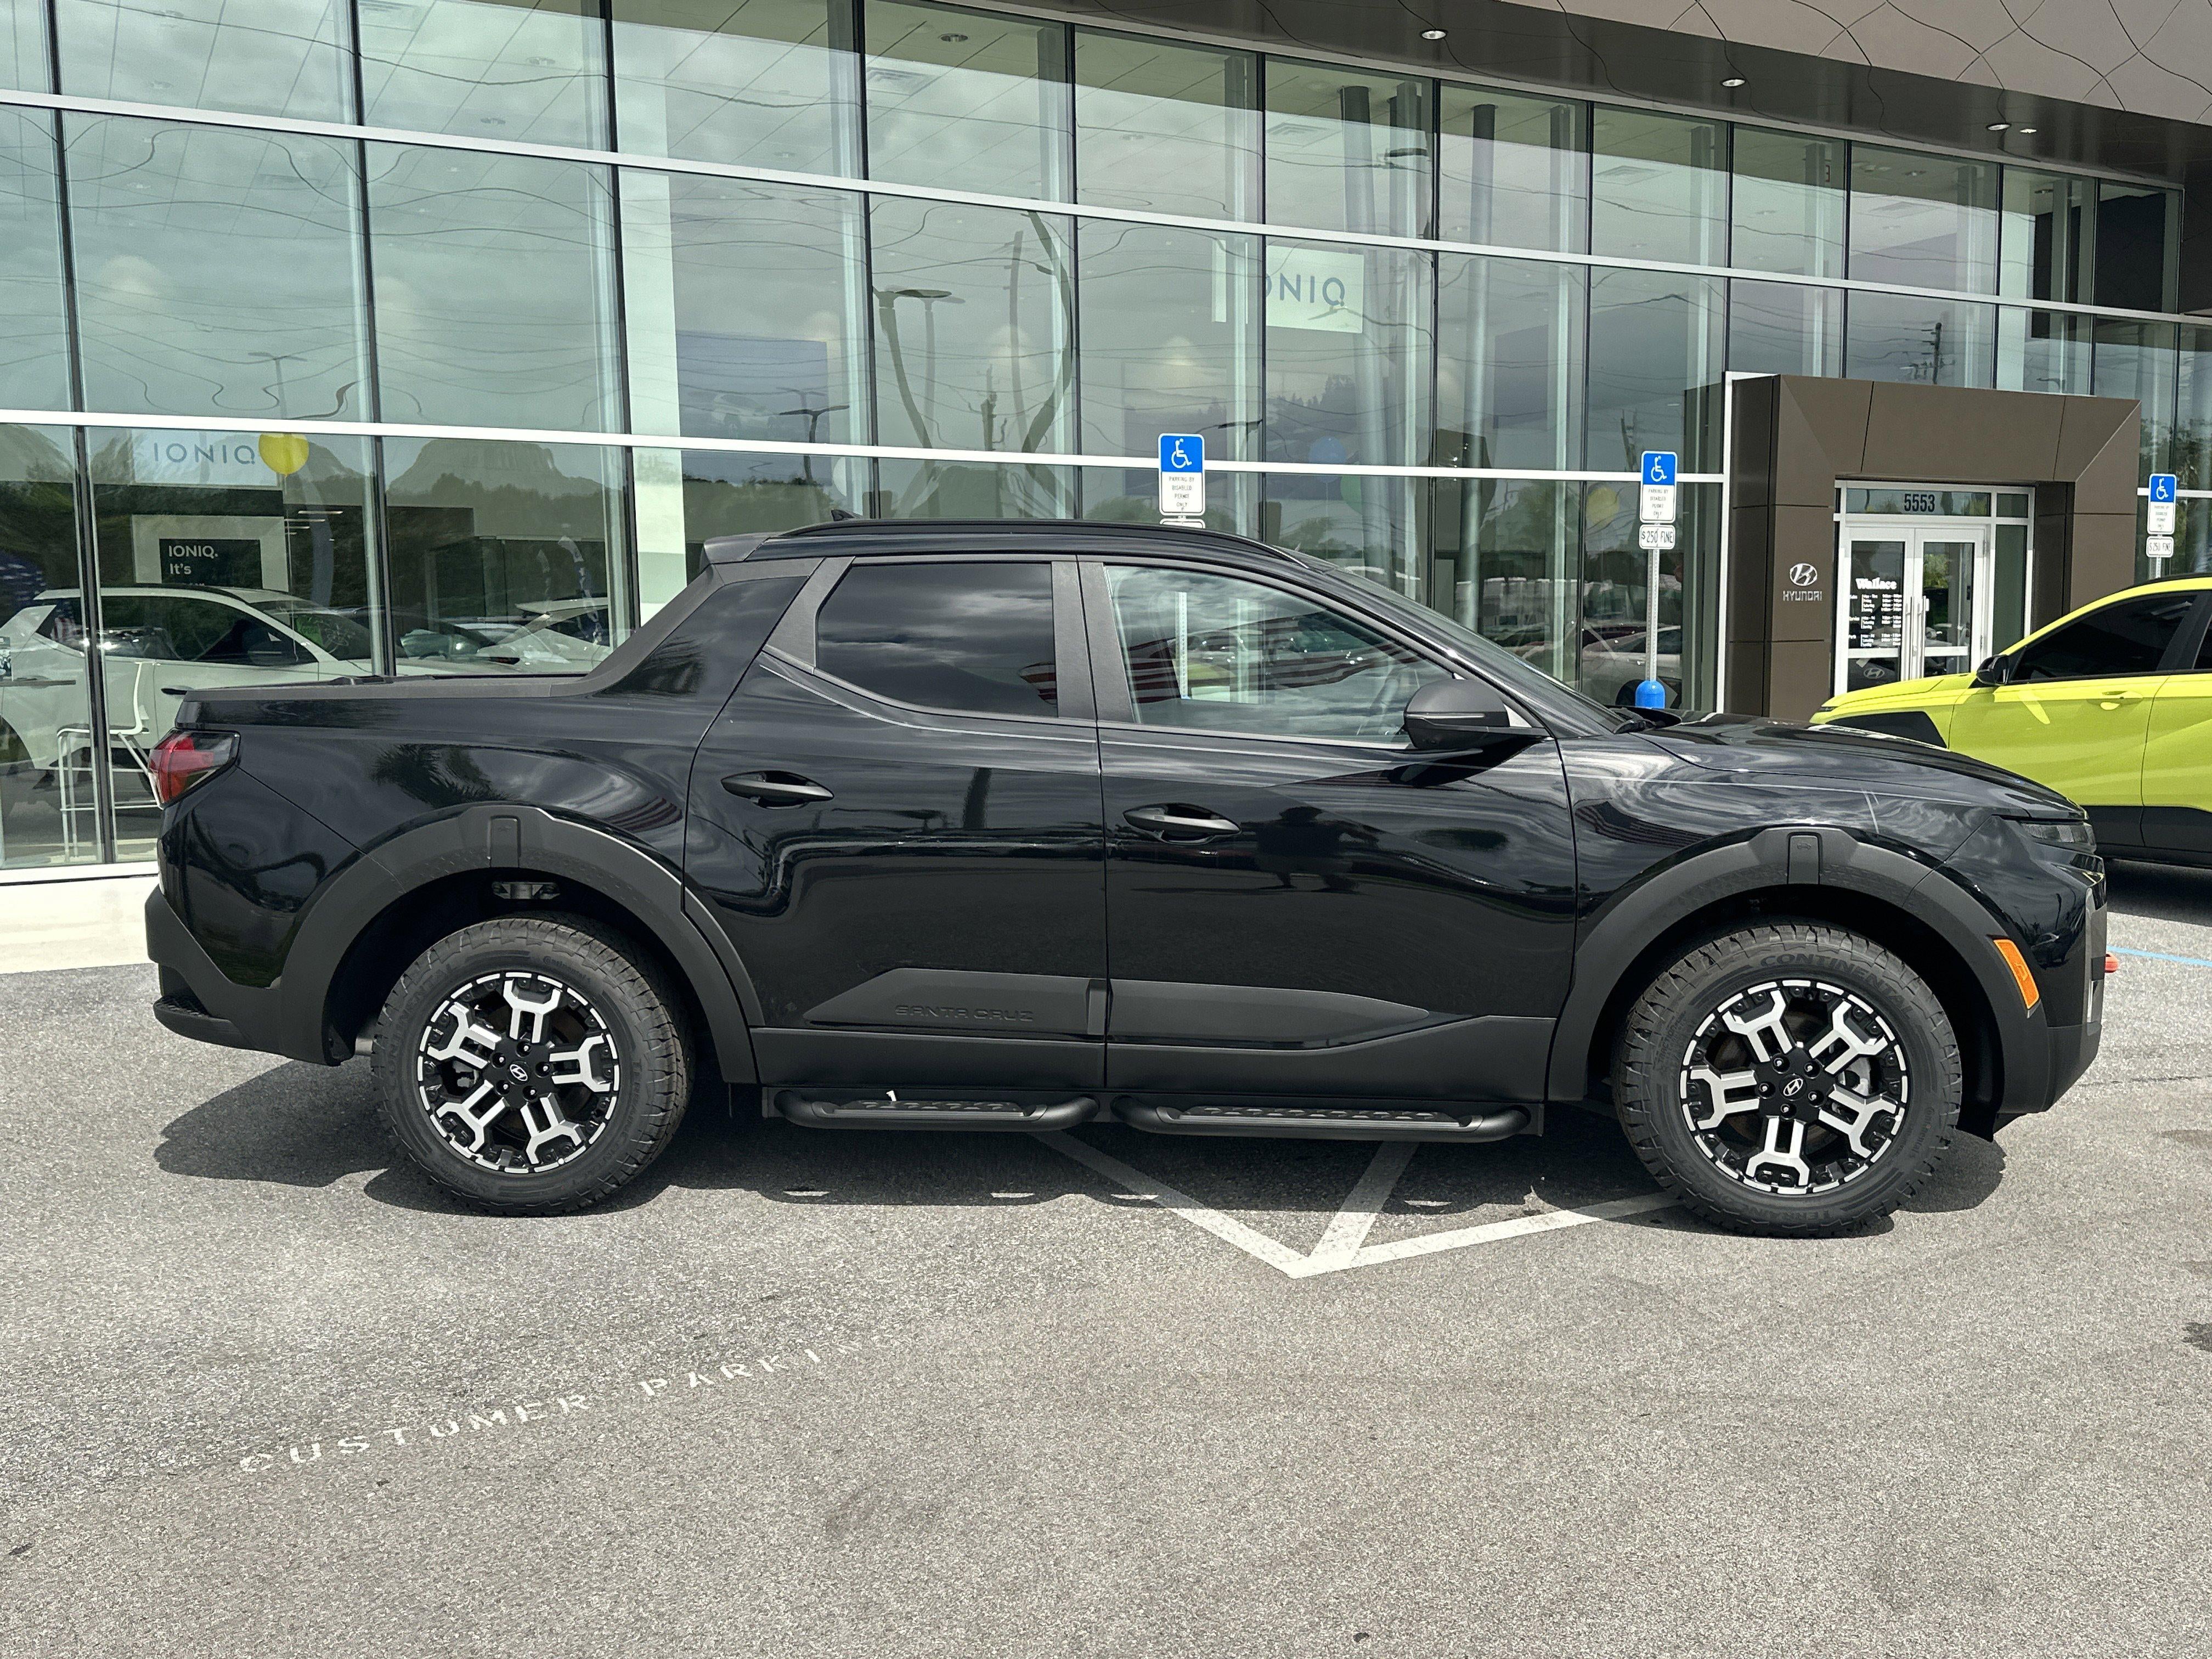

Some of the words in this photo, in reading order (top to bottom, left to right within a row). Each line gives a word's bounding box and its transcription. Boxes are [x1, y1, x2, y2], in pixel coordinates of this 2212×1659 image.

[1266, 273, 1345, 306] NIQ
[153, 442, 255, 465] IONIQ
[1904, 494, 1935, 512] 5553
[1661, 531, 1673, 544] FINE
[168, 545, 218, 559] IONIQ.
[170, 563, 192, 574] It's
[1855, 577, 1897, 589] Wallace
[1783, 591, 1822, 602] HYUNDAI
[1760, 953, 1913, 1020] CONTINENTAL
[895, 1005, 968, 1019] SANTA
[973, 1008, 1034, 1022] CRUZ
